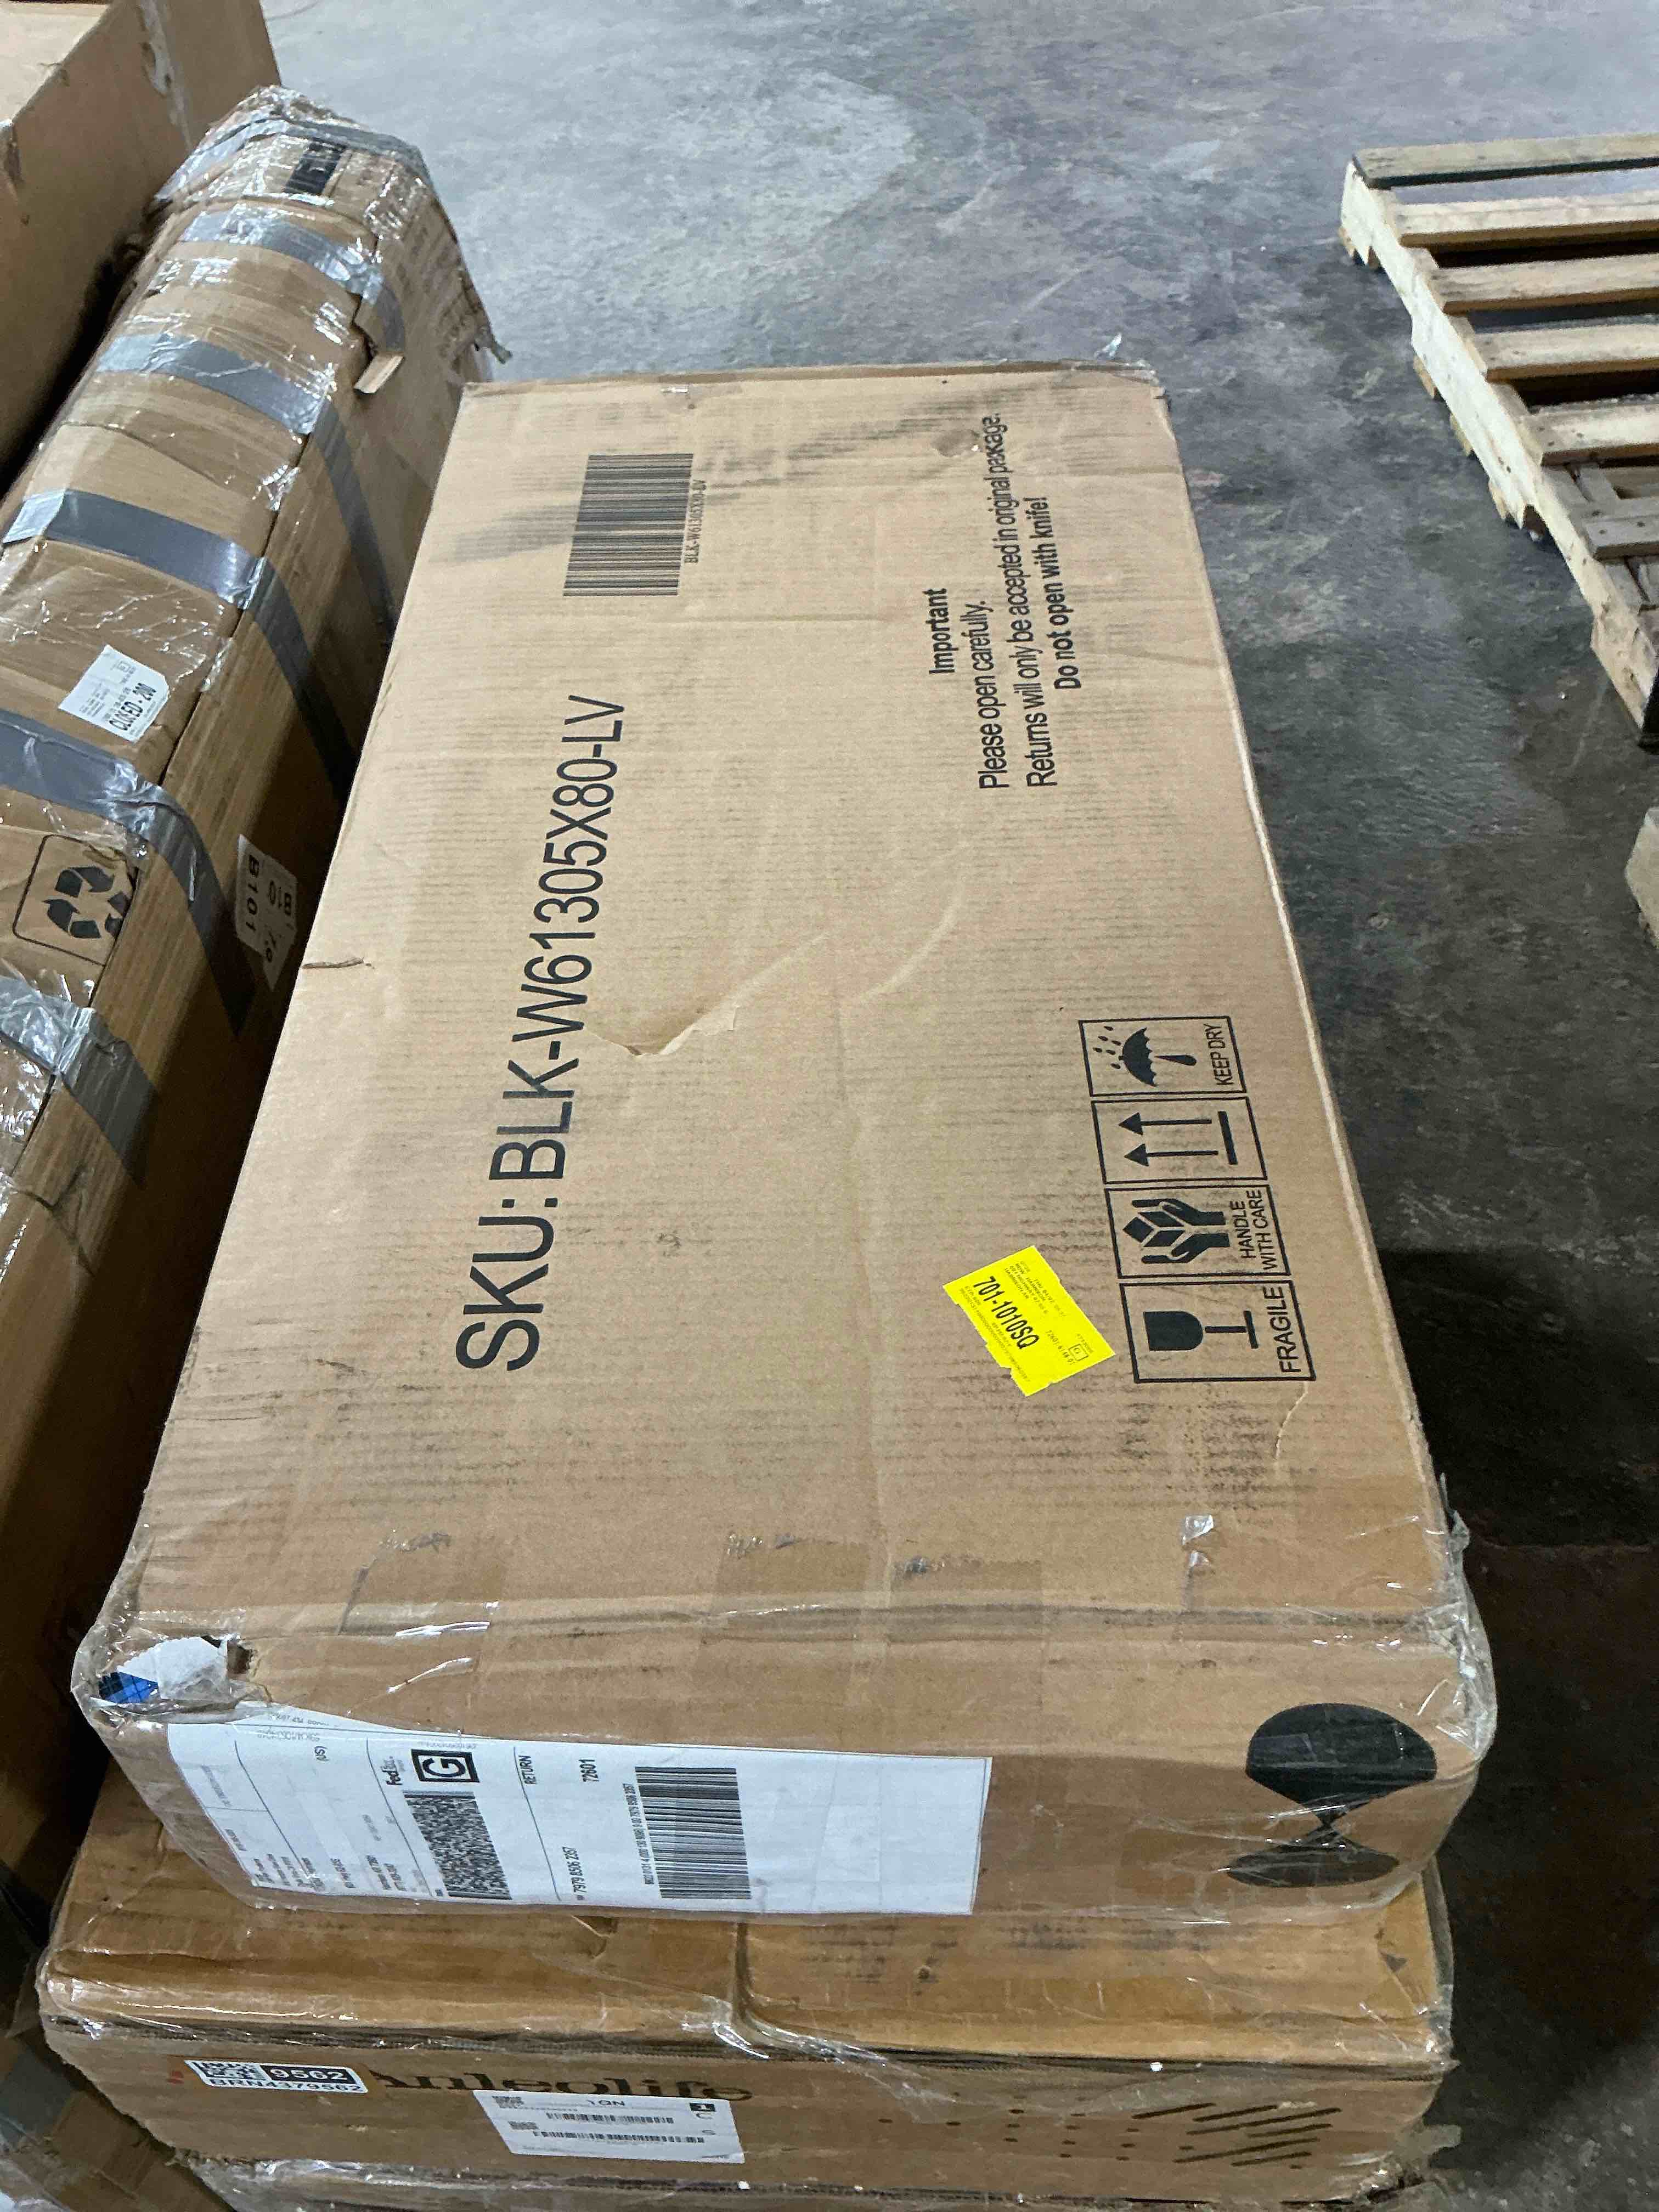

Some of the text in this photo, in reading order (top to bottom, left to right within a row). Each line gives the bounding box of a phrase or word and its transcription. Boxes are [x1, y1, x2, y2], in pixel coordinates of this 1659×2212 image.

[982, 413, 1057, 787] Returns will only be accepted in original package.
[1023, 496, 1081, 689] Do not open with knife!
[922, 588, 959, 674] Important
[960, 601, 1009, 789] Please open carefully.
[1203, 1024, 1234, 1085] KEEP DRY
[1230, 1200, 1256, 1259] HANDLE
[1246, 1189, 1278, 1270] WITH CARE
[973, 1276, 1040, 1350] 701-1010SQ
[1263, 1286, 1301, 1373] FRAGILE
[422, 1758, 466, 1778] G
[518, 1755, 537, 1784] RETURN
[578, 1759, 599, 1782] 72601
[269, 2068, 348, 2081] 9562
